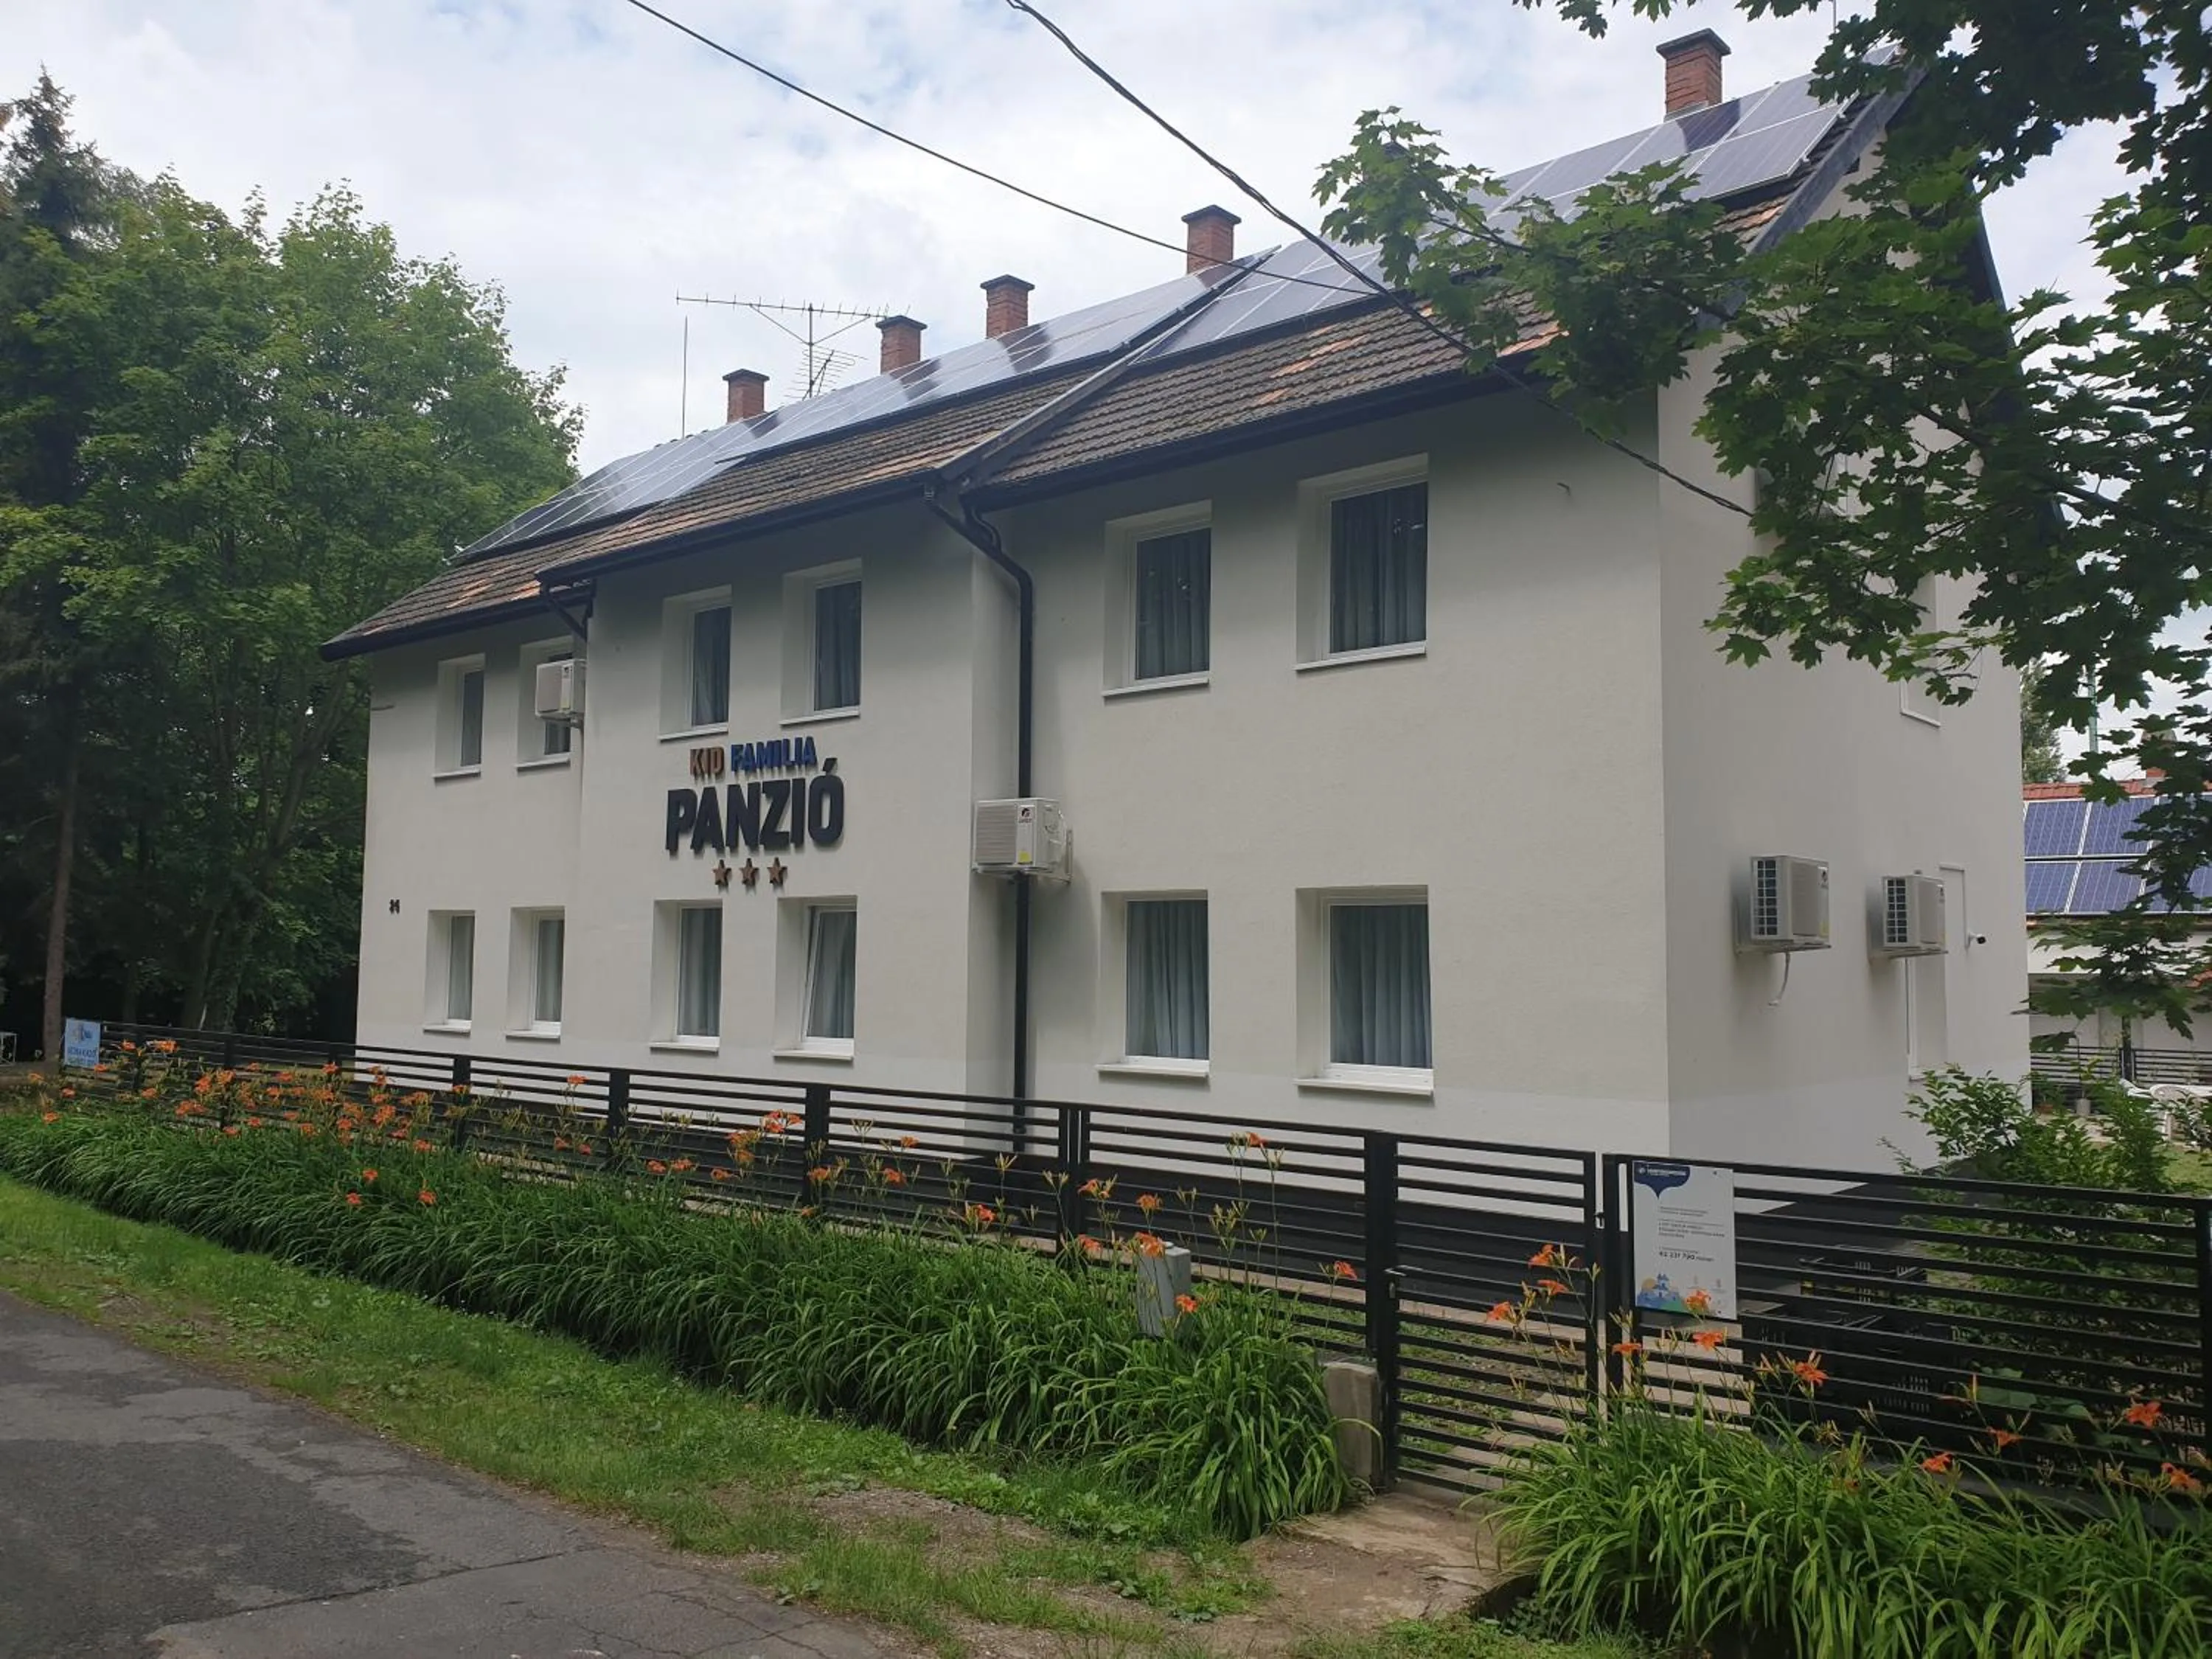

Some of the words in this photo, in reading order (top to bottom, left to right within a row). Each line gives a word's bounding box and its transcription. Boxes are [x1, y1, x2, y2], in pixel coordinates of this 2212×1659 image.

[689, 746, 725, 776] KID
[731, 736, 817, 772] FAMILIA
[665, 757, 844, 851] PANZIÓ
